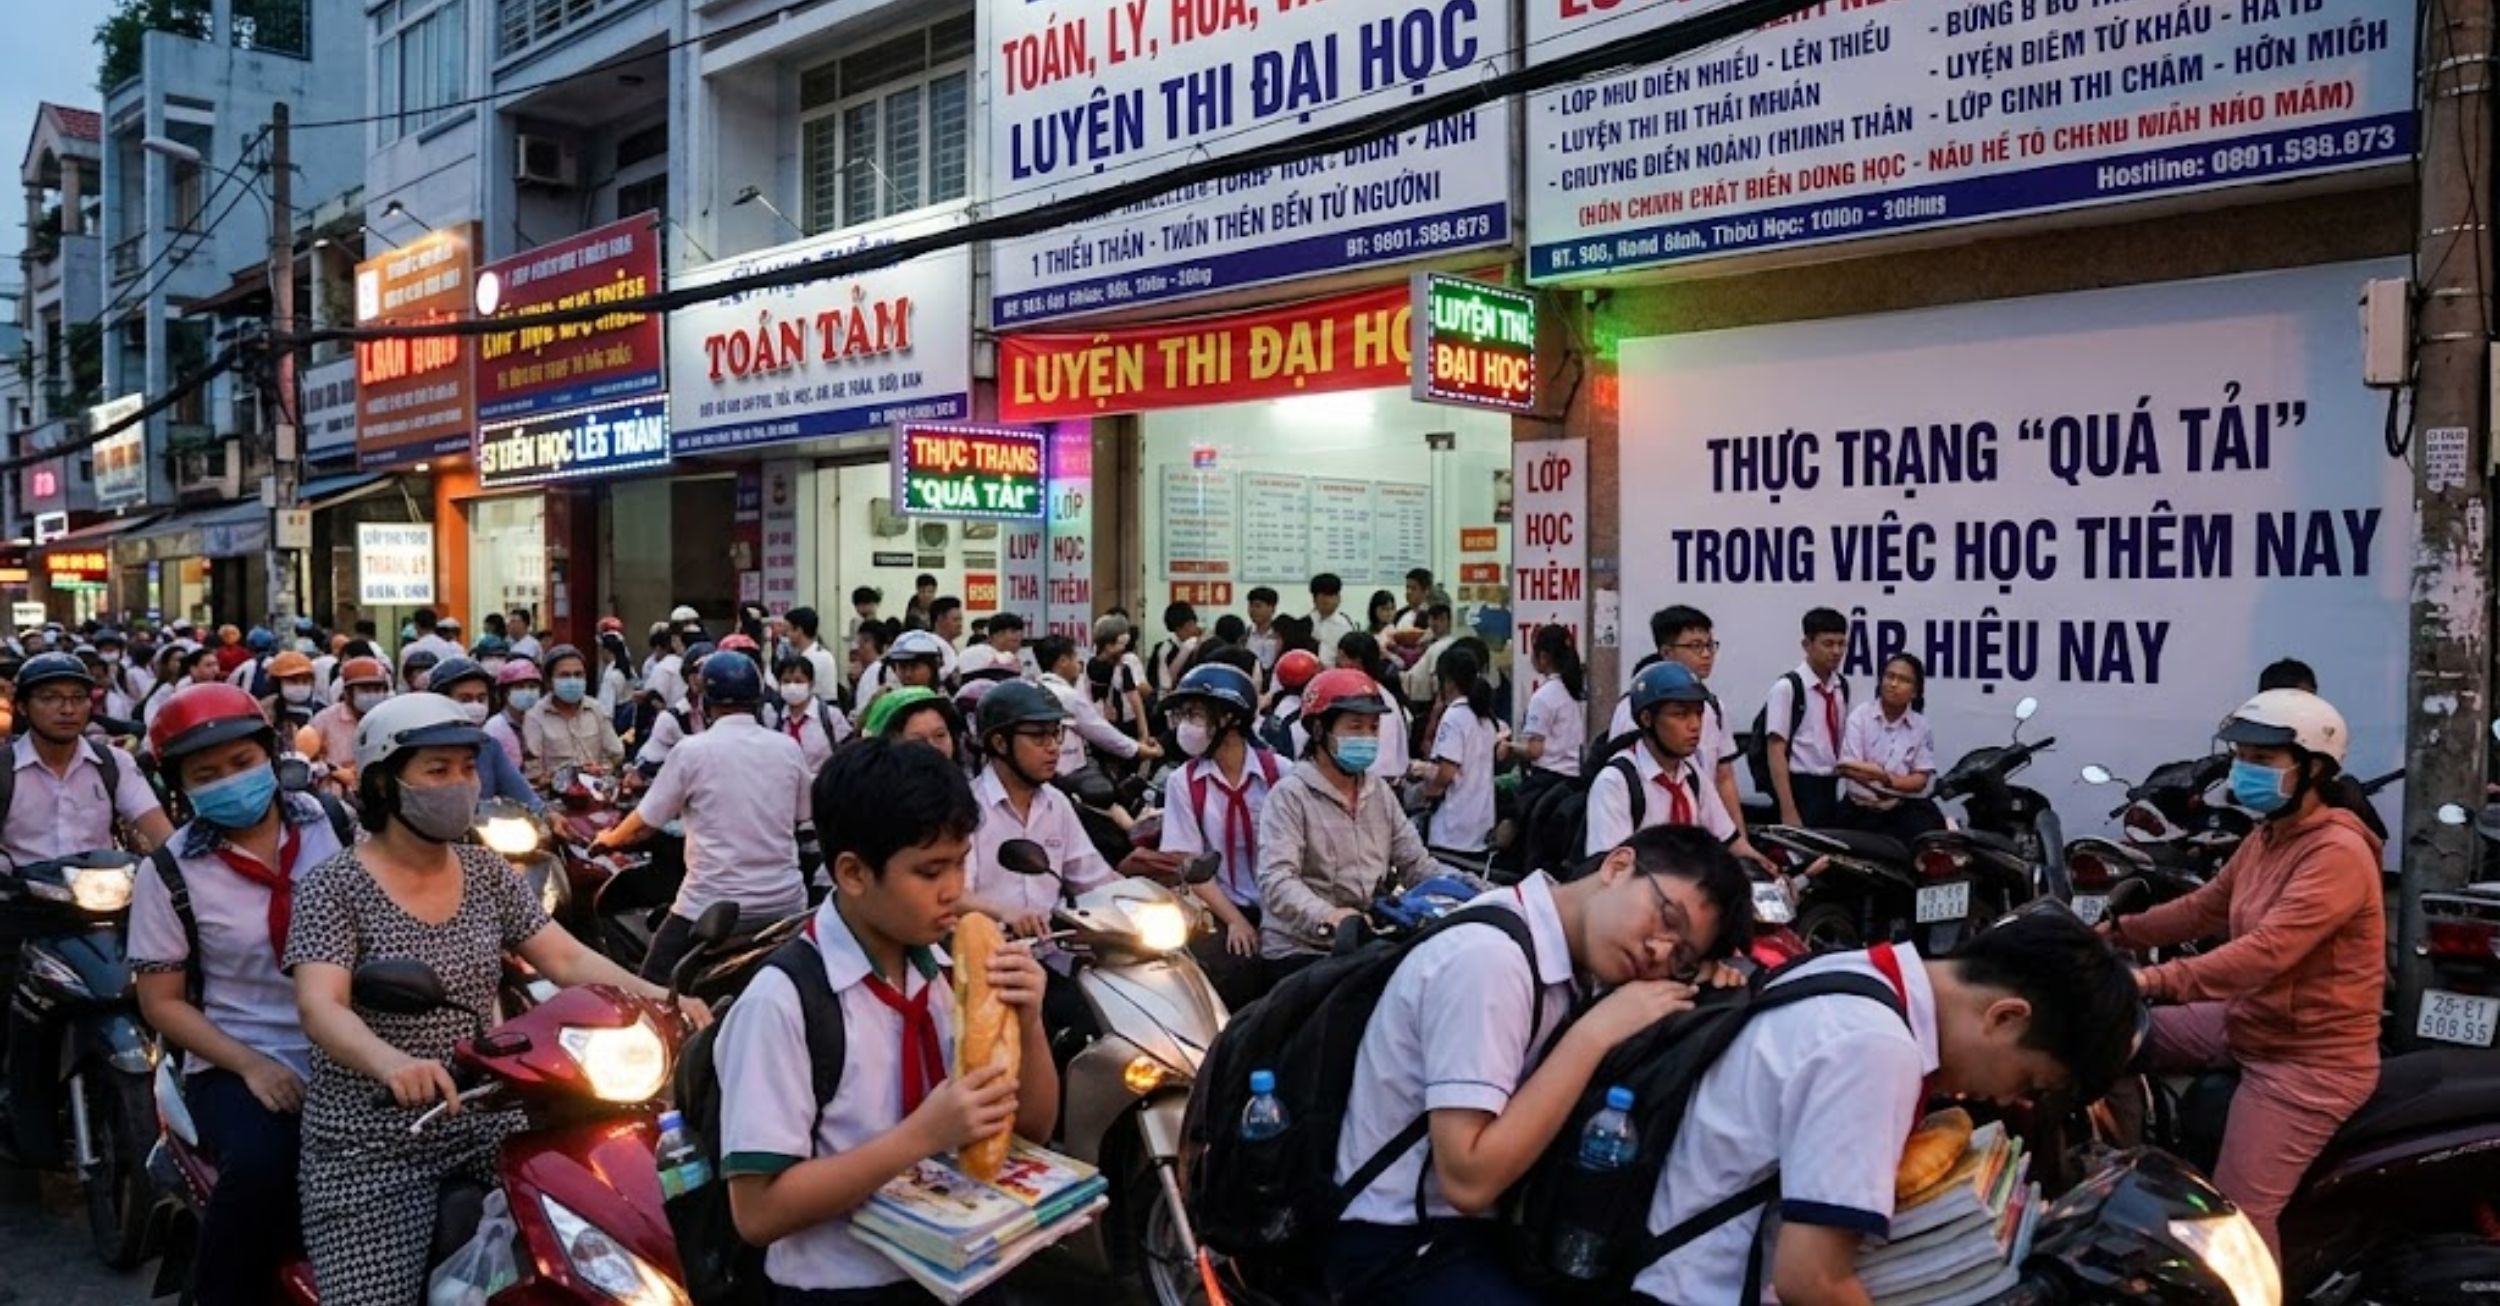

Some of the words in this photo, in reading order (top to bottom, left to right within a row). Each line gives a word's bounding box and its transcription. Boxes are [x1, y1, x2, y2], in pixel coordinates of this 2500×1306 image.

[1003, 13, 1096, 96] TOÁN,
[1011, 85, 1144, 181] LUYỆN
[1159, 62, 1233, 141] THI
[1250, 33, 1338, 124] ĐẠI
[1359, 0, 1478, 96] HỌC
[2070, 69, 2112, 103] THI
[1628, 114, 1658, 141] THI
[1862, 153, 1906, 185] HỌC
[1014, 333, 1144, 408] LUYỆN
[1157, 330, 1233, 388] THI
[1248, 318, 1334, 388] ĐẠI
[1483, 351, 1529, 398] HỌC
[1706, 428, 1820, 504] THỰC
[1835, 421, 1998, 499] TRẠNG
[2018, 395, 2161, 486] “QUÁ
[2179, 380, 2306, 473] TẢI”
[1526, 513, 1573, 552] HỌC
[1671, 526, 1815, 583] TRONG
[1830, 510, 1937, 595] VIỆC
[1955, 518, 2057, 594] HỌC
[2076, 499, 2233, 579] THÊM
[2255, 507, 2382, 577] NAY
[1924, 606, 2040, 694] HIỆU
[2059, 620, 2171, 684] NAY
